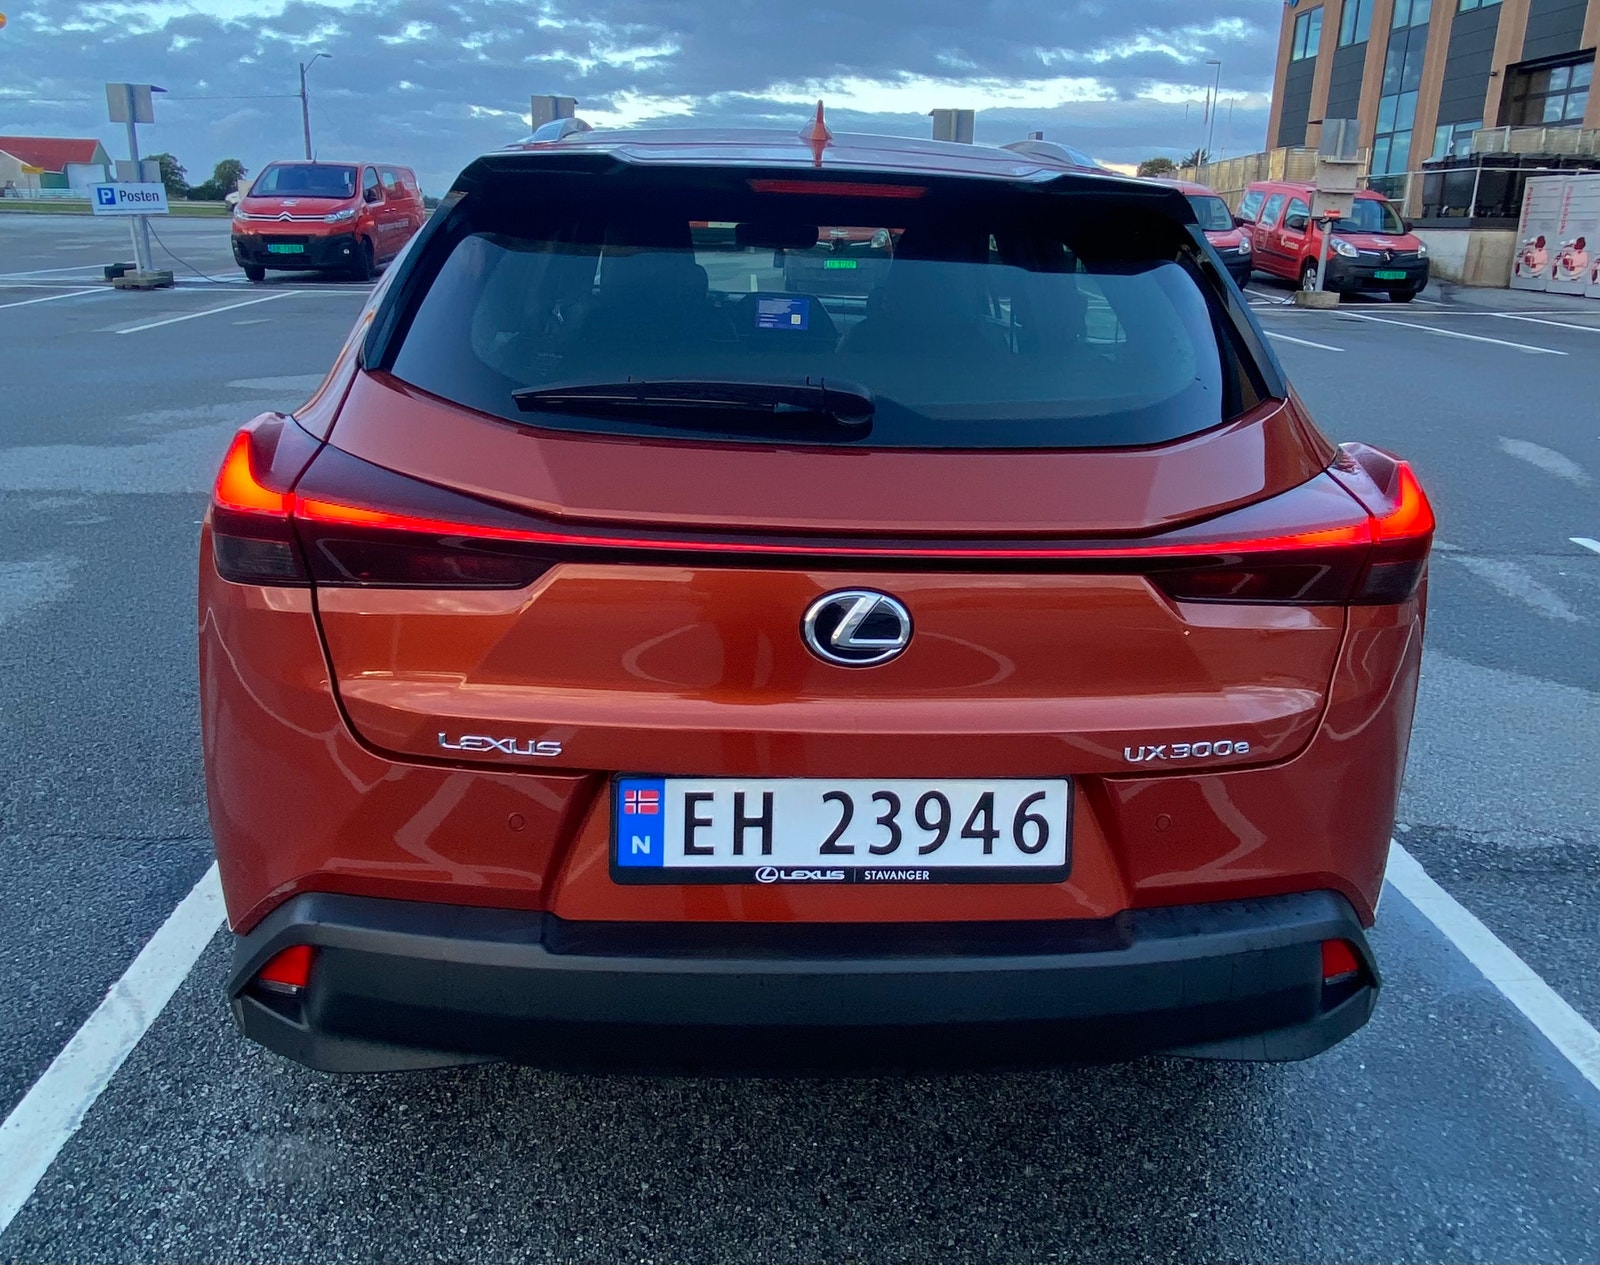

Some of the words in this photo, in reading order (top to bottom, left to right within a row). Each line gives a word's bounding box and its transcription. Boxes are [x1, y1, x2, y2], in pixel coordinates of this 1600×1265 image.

[100, 189, 112, 204] P
[119, 190, 160, 202] Posten
[438, 732, 563, 757] LEXUS
[683, 791, 774, 856] EH
[819, 791, 1050, 856] 23946
[632, 836, 651, 855] N
[779, 869, 846, 881] LEXUS
[864, 870, 930, 882] STAVANGER
